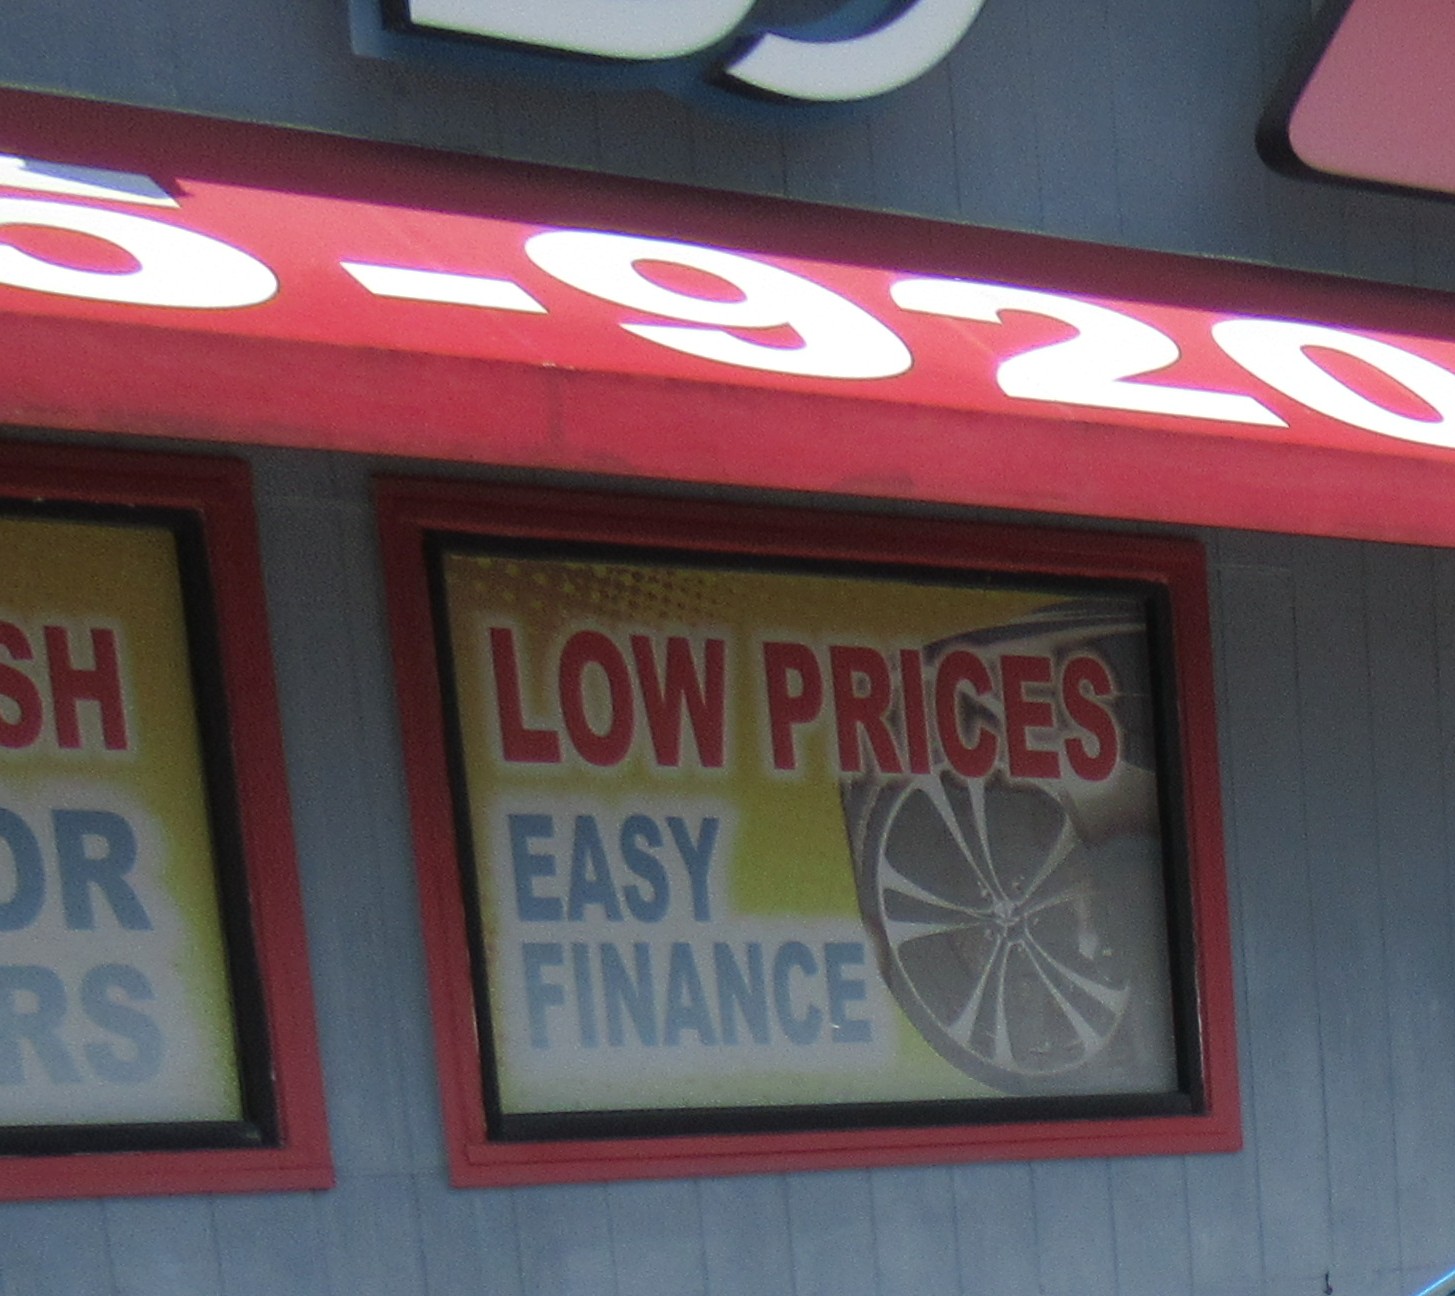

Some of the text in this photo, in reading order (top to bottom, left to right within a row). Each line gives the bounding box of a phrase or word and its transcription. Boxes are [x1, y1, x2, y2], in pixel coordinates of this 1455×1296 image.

[488, 626, 1120, 783] LOW PRICES
[507, 813, 720, 924] EASY
[521, 940, 873, 1049] FINANCE
